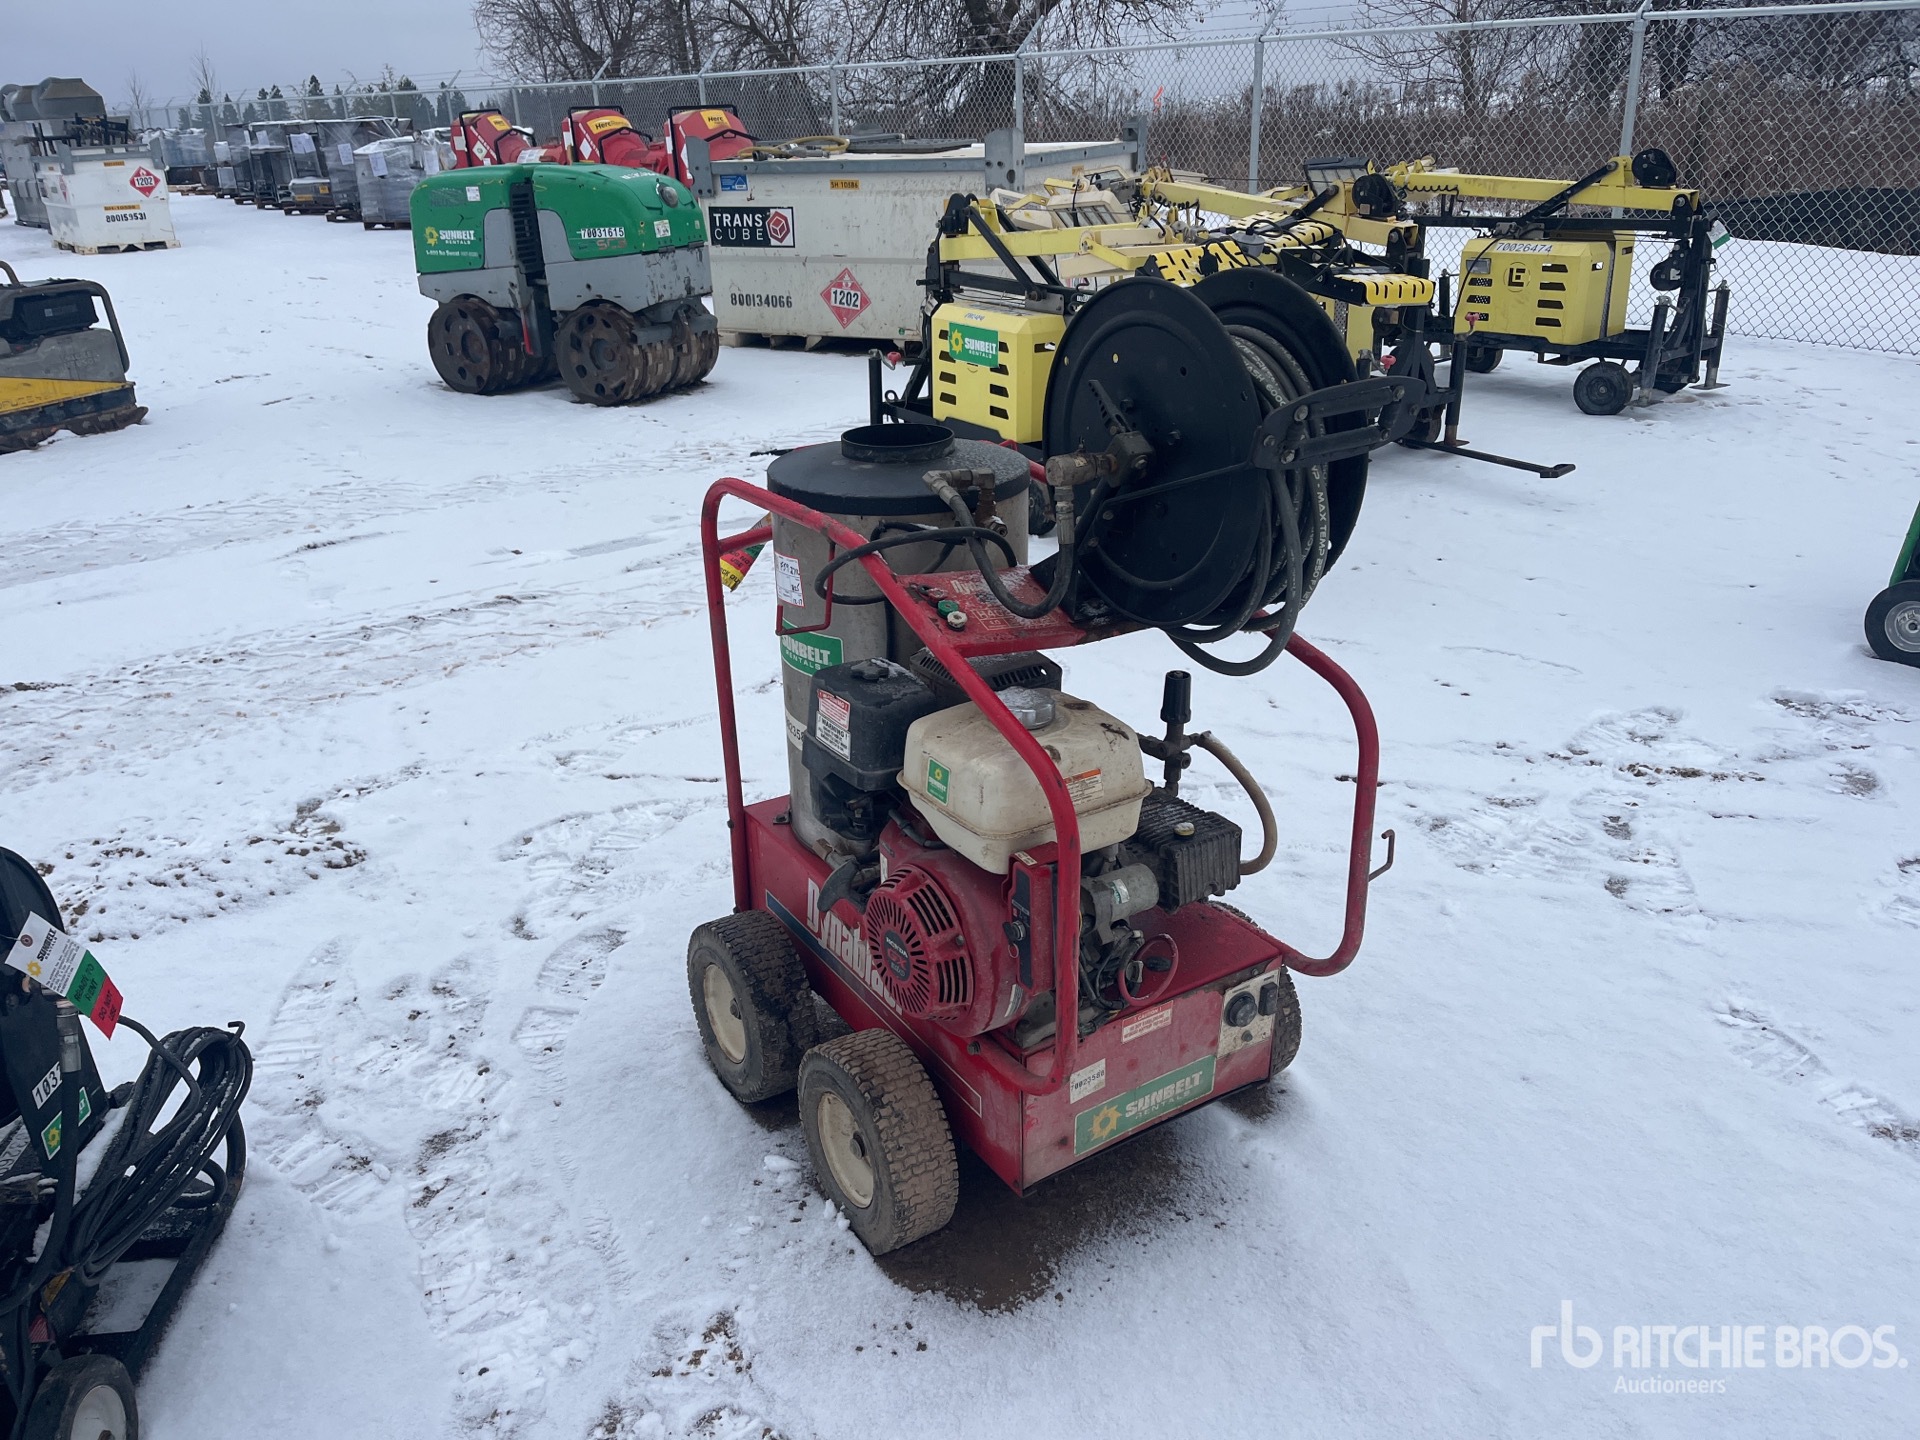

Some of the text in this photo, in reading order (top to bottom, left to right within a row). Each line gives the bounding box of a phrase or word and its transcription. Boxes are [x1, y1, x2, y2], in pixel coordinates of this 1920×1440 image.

[136, 177, 153, 186] 1202
[713, 213, 763, 228] TRANS
[439, 230, 475, 241] SUNBELT
[582, 227, 625, 239] 70031615
[714, 228, 764, 240] CUBE
[1496, 242, 1553, 253] 70026474
[730, 292, 793, 309] 800134066
[832, 289, 859, 308] 1202
[964, 337, 997, 355] SUNBELT
[968, 349, 992, 359] RENTALS
[1316, 491, 1327, 522] MAX
[1318, 524, 1327, 556] TEMP
[1312, 558, 1324, 579] 250
[781, 633, 831, 666] SUNBELT
[786, 649, 821, 671] RENTALS
[822, 717, 845, 738] WARNING
[37, 927, 57, 962] SUNBELT
[1125, 1070, 1203, 1118] SUNBELT
[1135, 1089, 1191, 1120] RENTALS
